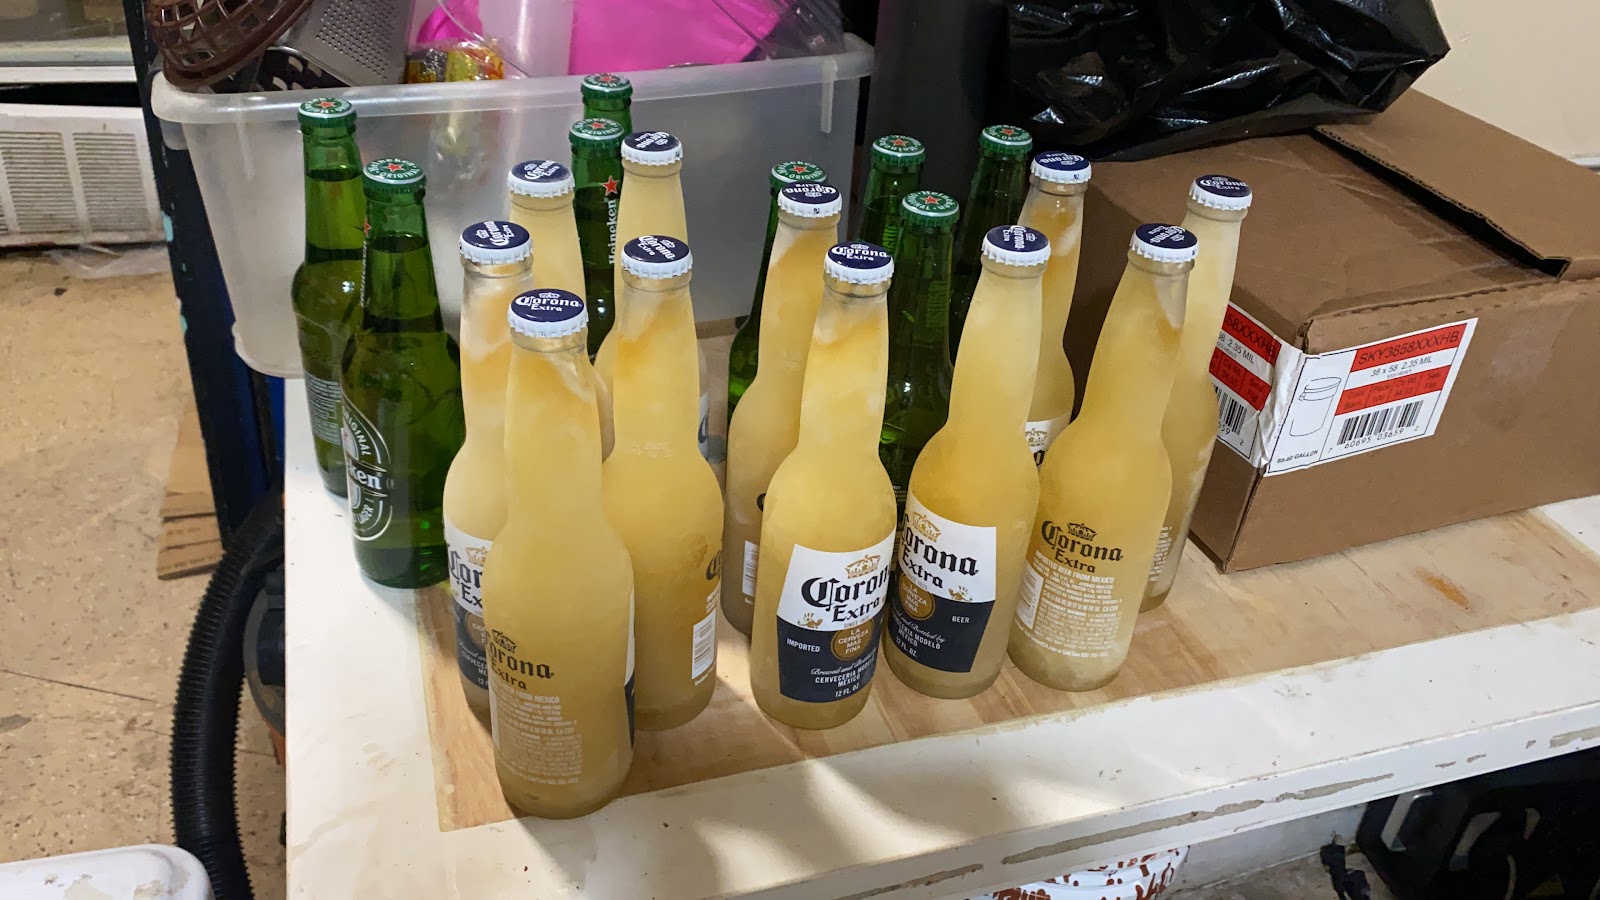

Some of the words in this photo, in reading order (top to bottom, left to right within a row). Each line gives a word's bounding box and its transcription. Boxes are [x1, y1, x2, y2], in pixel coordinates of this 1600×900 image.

[783, 185, 837, 195] Corona
[1199, 179, 1249, 188] Corona
[638, 235, 676, 260] Corona
[831, 245, 890, 258] Corona
[515, 295, 581, 308] Corona
[531, 303, 563, 312] Extra
[1226, 313, 1276, 359] 58XXXHB
[1358, 330, 1460, 365] SKY3858XXXHB
[1370, 367, 1381, 377] 38
[1388, 364, 1398, 372] 58
[1401, 359, 1418, 370] 2.35
[1418, 356, 1433, 366] MIL
[1344, 437, 1372, 449] 60695
[1376, 427, 1405, 441] 03659
[1294, 449, 1319, 461] GALLON
[1041, 520, 1122, 562] Corona
[902, 547, 943, 589] Extra
[1054, 547, 1096, 573] Extra
[1057, 563, 1072, 577] BEER
[1072, 571, 1091, 581] FROM
[1091, 575, 1115, 584] MEXICO
[832, 597, 880, 623] Extra
[951, 615, 970, 624] BEER
[838, 629, 869, 645] CERVEZA
[850, 627, 861, 636] LA
[897, 627, 918, 647] MEXICO
[786, 637, 821, 653] IMPORTED
[846, 639, 861, 649] MAS
[914, 633, 941, 650] MODELO
[845, 645, 861, 655] FINA
[490, 660, 528, 690] Extra
[815, 669, 856, 684] CERVECERIA
[837, 673, 861, 688] MEXICO
